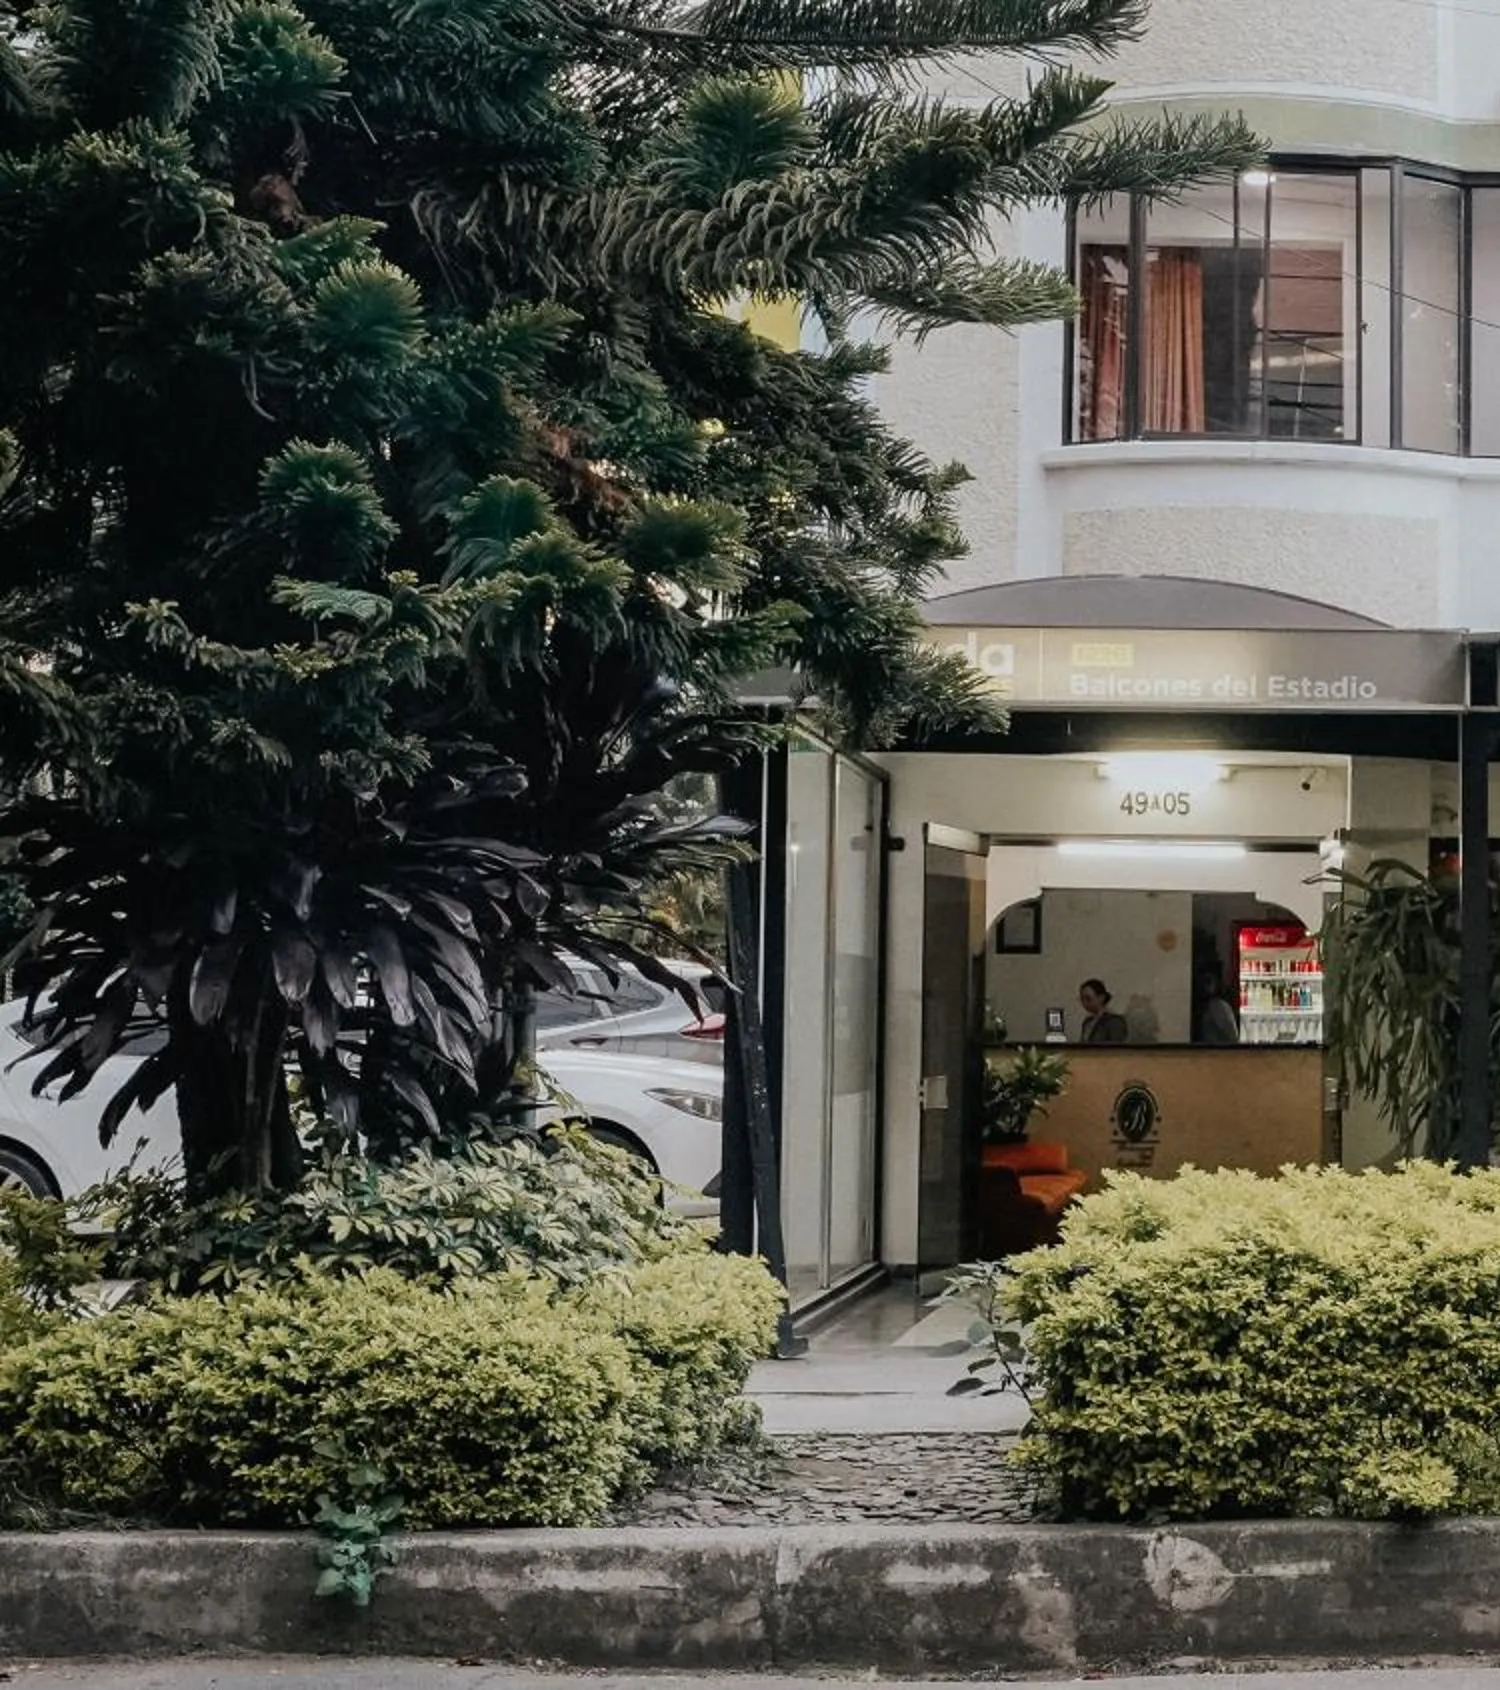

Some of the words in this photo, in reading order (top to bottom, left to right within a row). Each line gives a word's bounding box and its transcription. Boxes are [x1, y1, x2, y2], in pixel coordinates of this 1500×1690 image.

[1070, 673, 1202, 697] Balcones
[1212, 674, 1256, 698] del
[1268, 676, 1377, 699] Estadio
